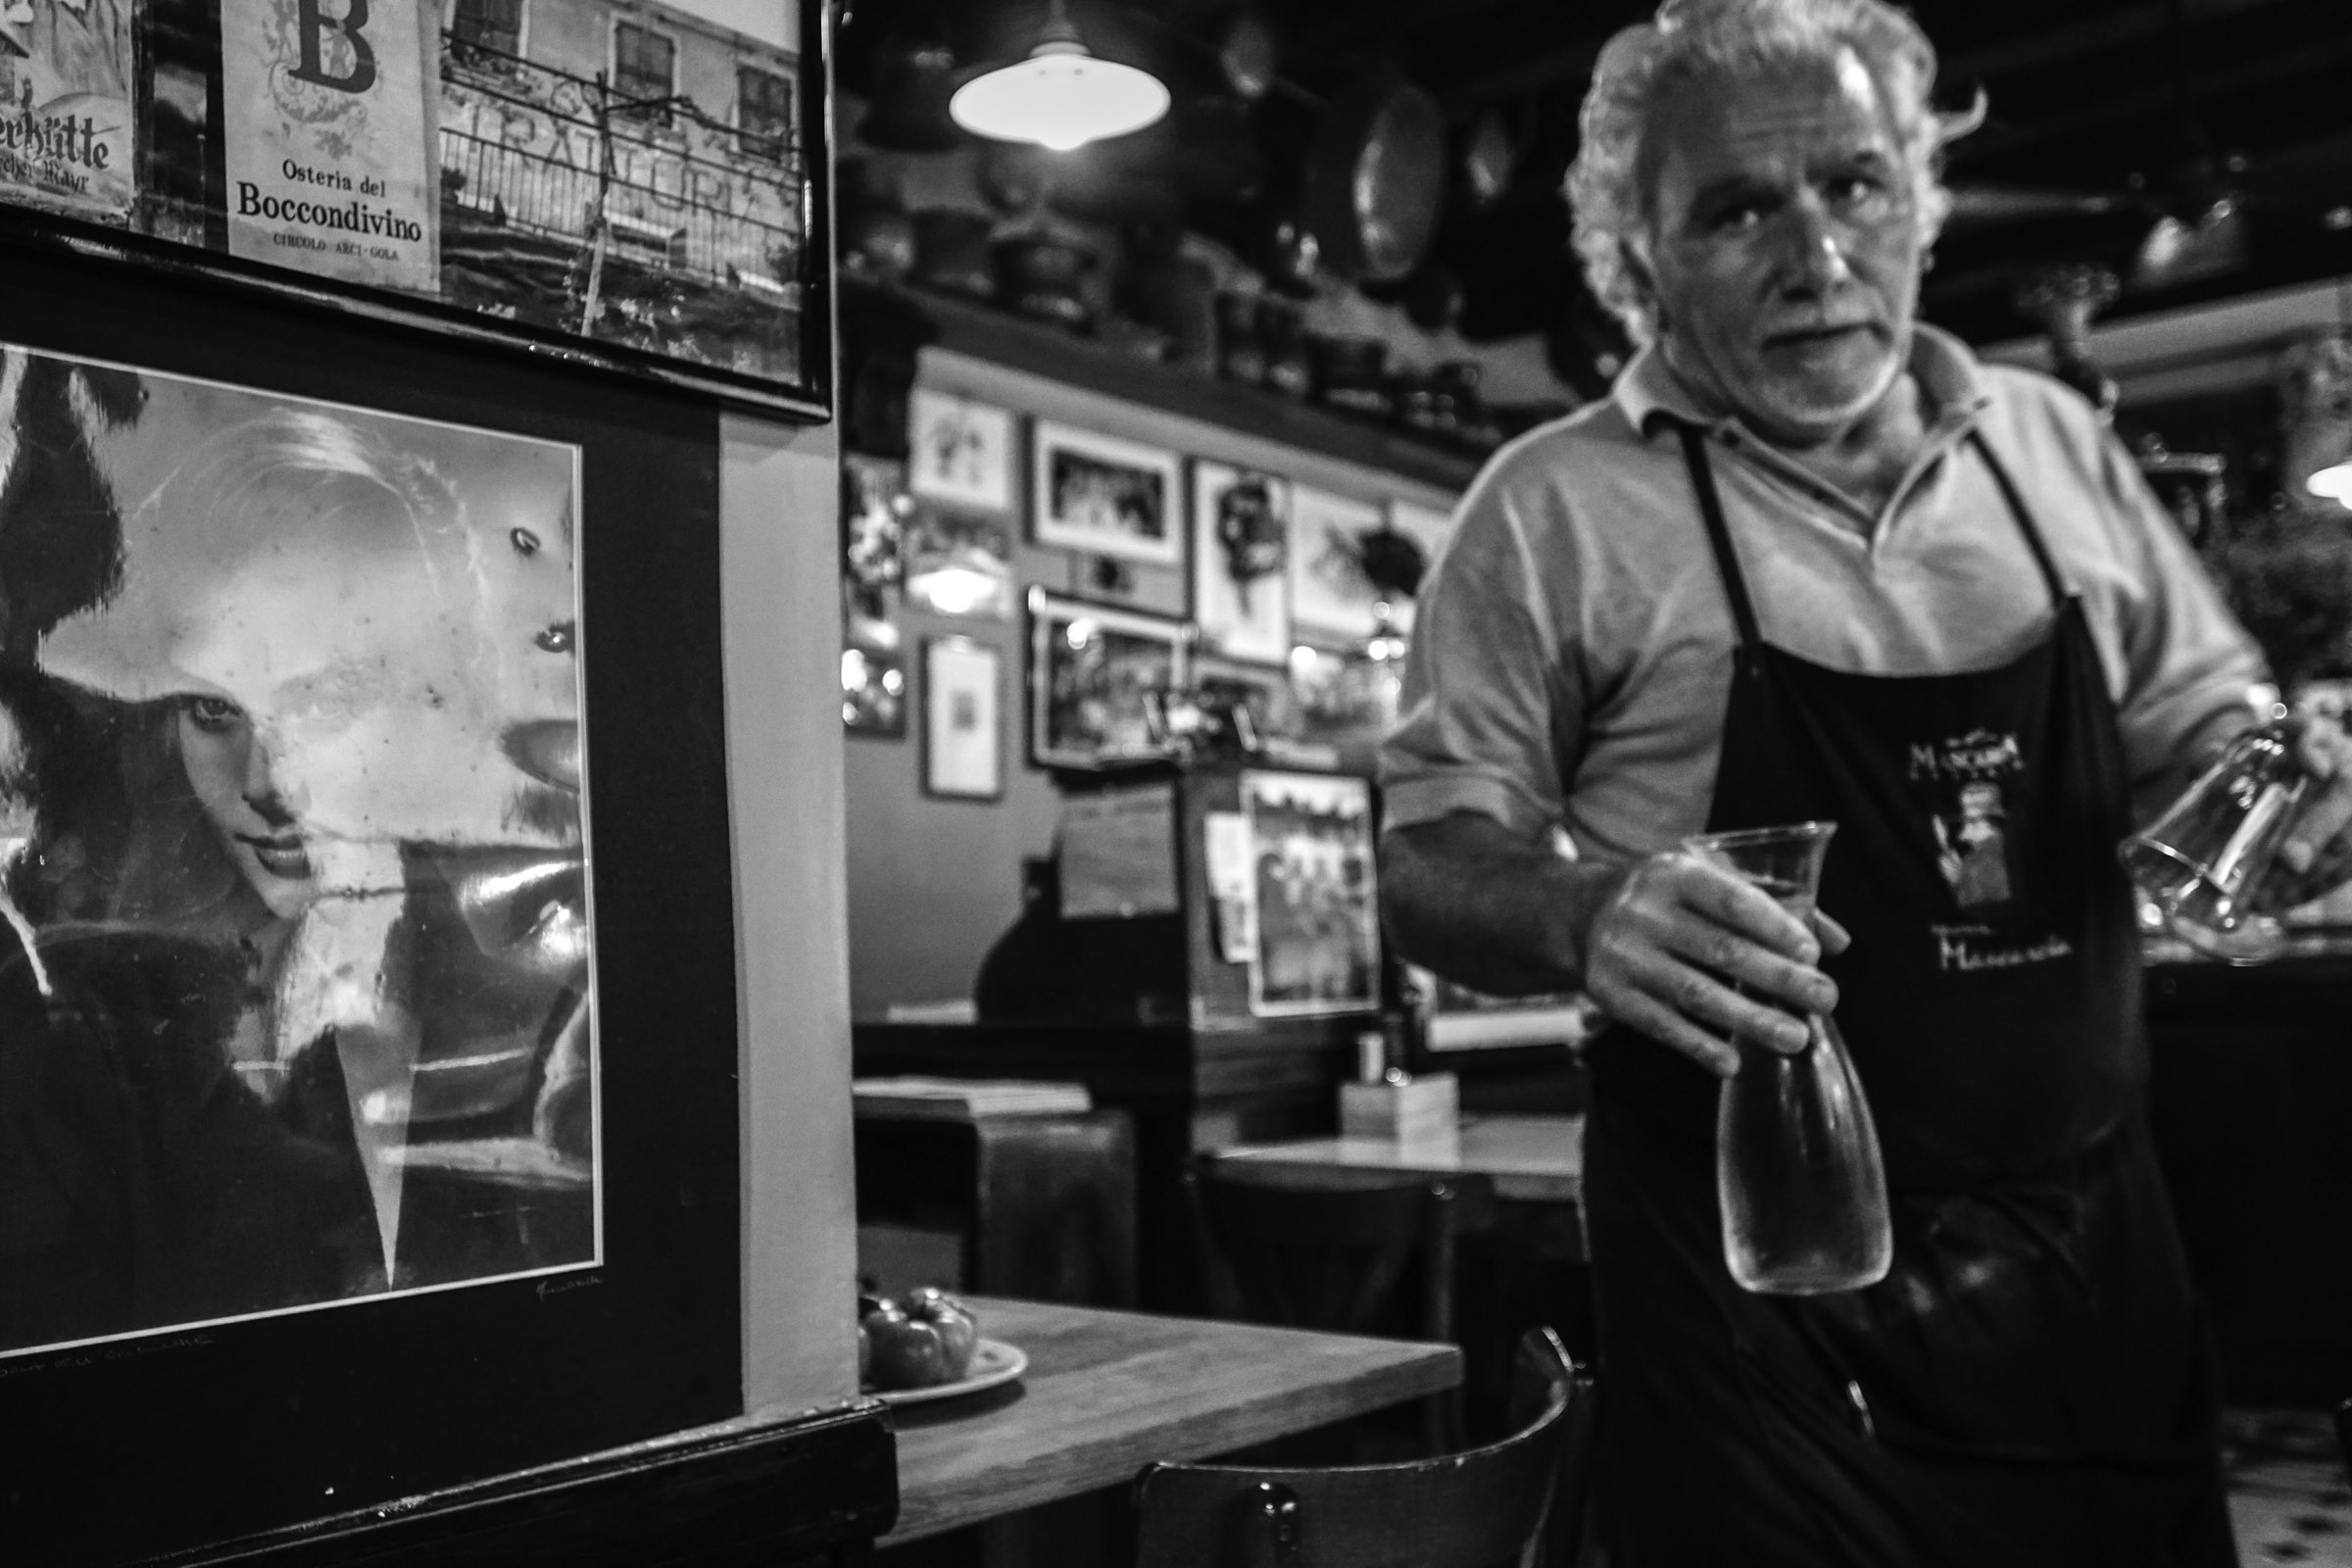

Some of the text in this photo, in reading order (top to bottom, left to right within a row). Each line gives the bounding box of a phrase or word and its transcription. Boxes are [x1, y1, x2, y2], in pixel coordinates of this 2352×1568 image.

[288, 0, 376, 94] B
[282, 158, 386, 198] Osteria del
[236, 180, 422, 242] Boccondivino
[273, 233, 326, 252] CIRCOLO
